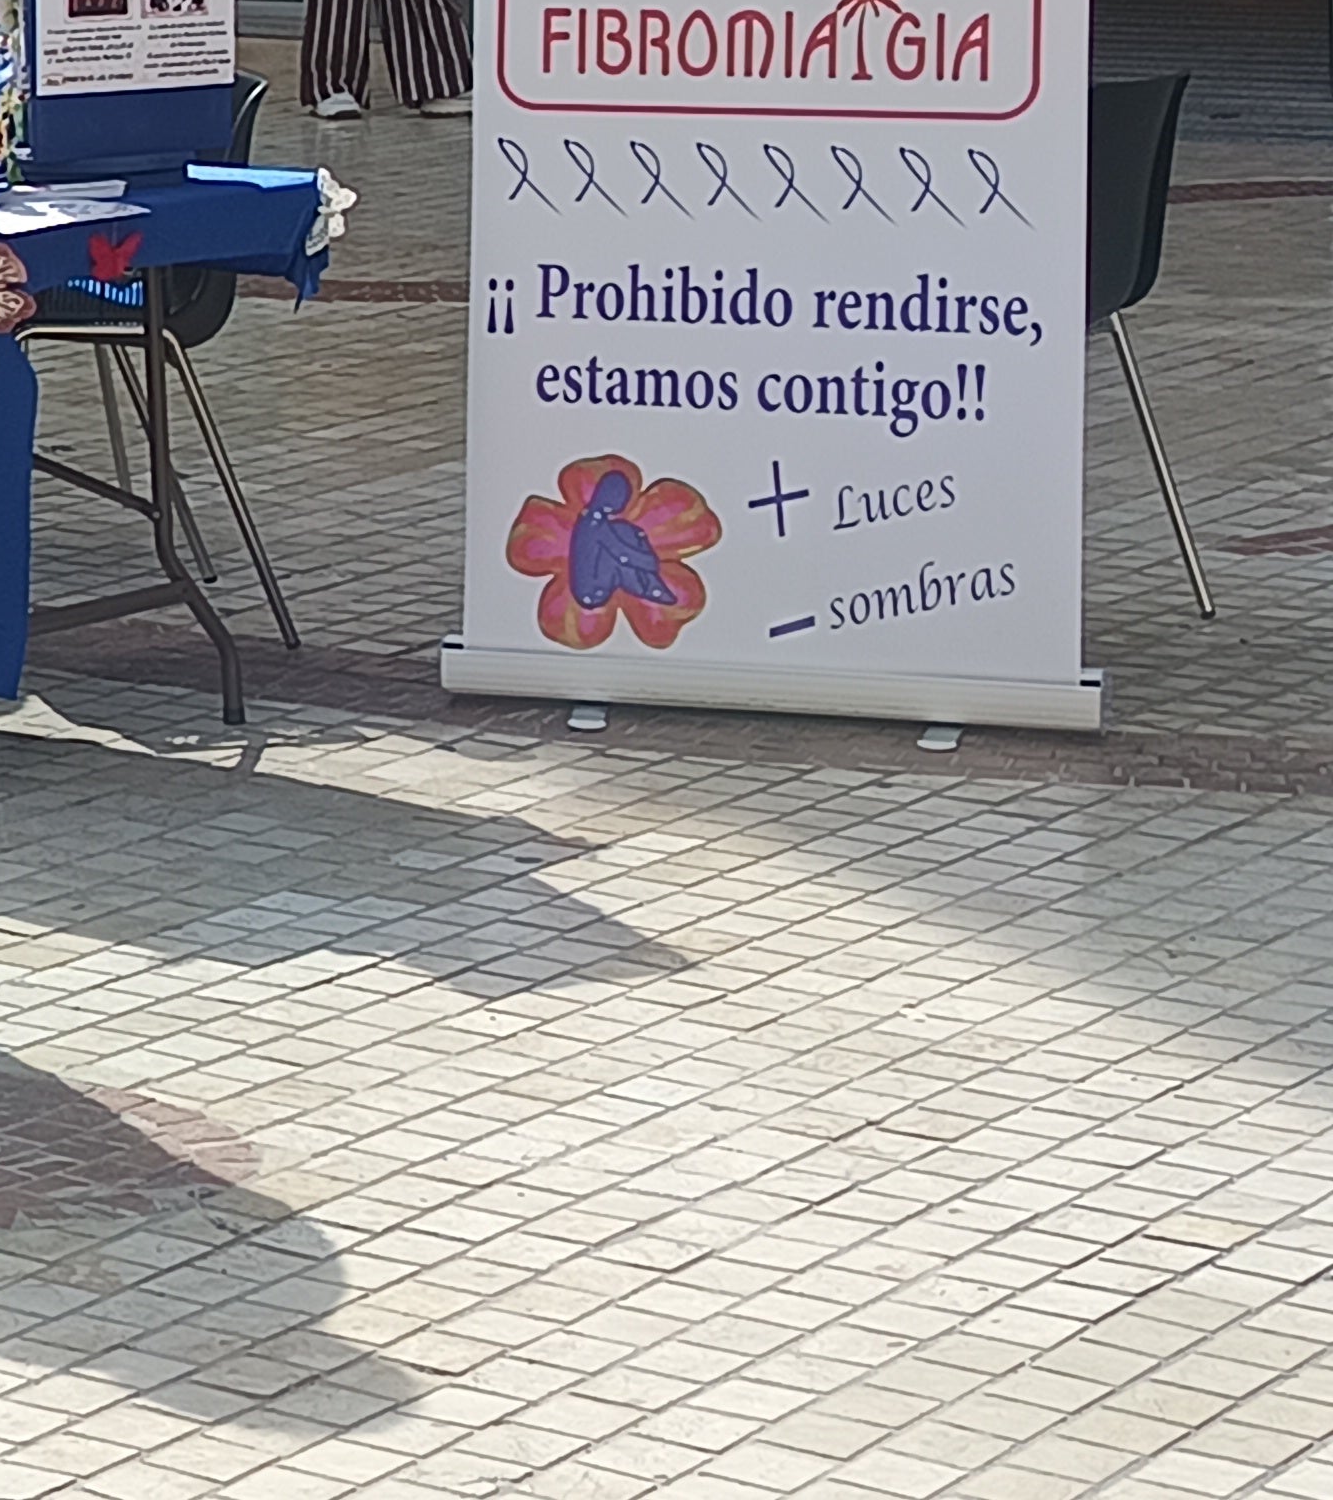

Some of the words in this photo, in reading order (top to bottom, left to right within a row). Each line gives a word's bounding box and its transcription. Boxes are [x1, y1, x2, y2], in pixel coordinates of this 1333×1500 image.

[535, 263, 794, 328] Prohibido
[811, 273, 1044, 347] rendirse,
[535, 355, 738, 411] estamos
[756, 360, 987, 438] contigo!!
[832, 473, 957, 532] Luces
[828, 560, 1018, 631] sombras
